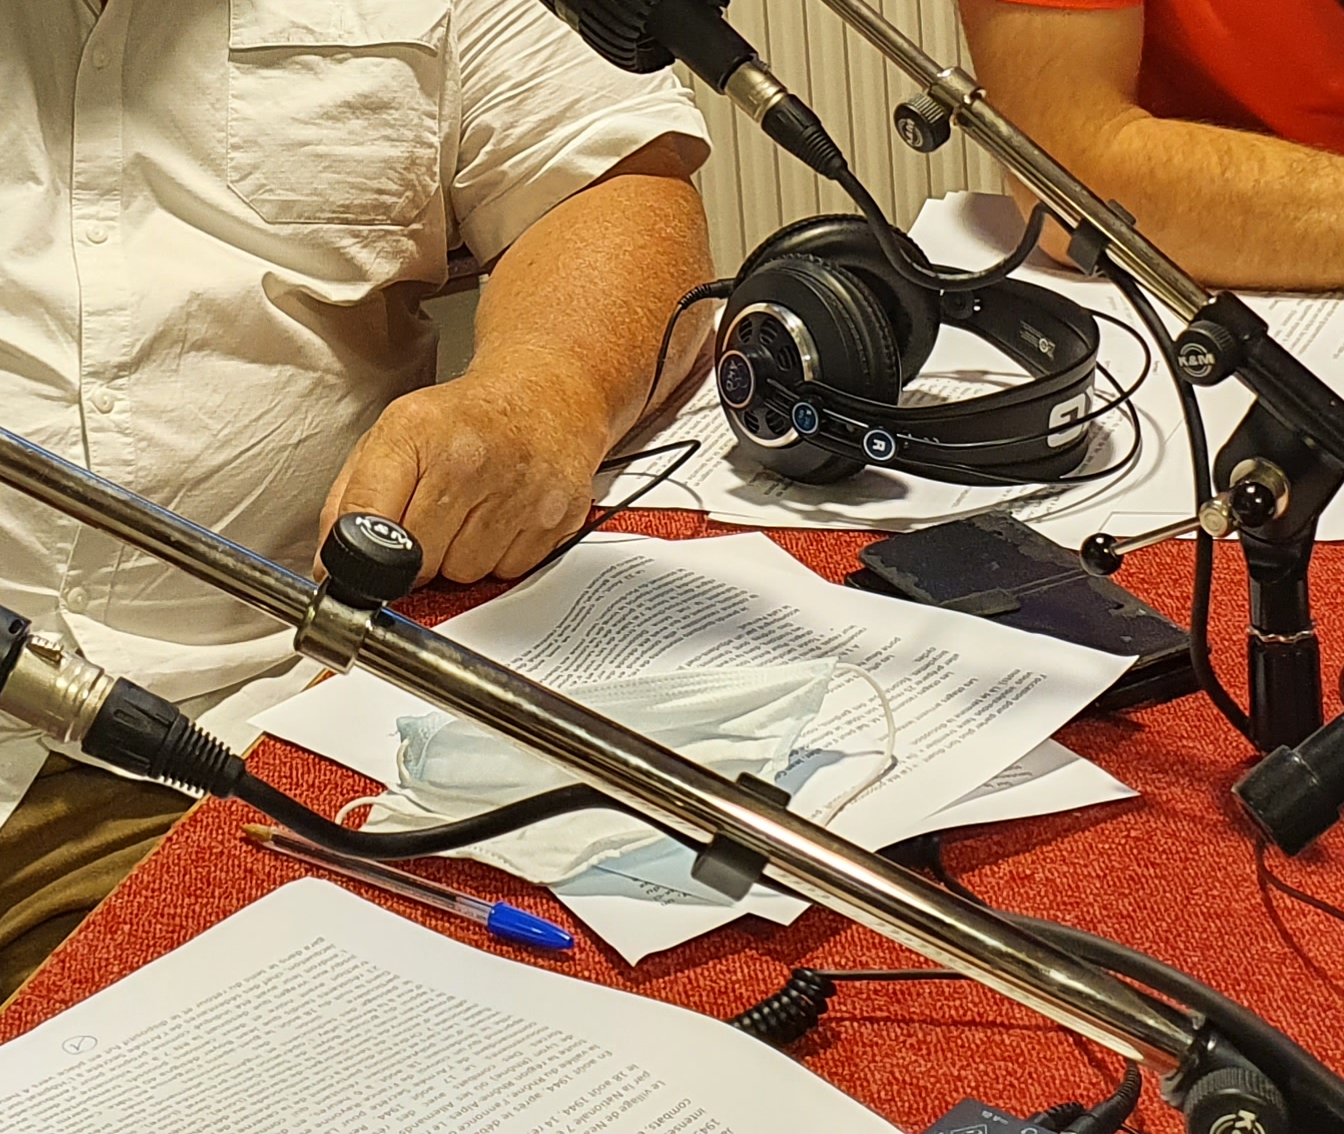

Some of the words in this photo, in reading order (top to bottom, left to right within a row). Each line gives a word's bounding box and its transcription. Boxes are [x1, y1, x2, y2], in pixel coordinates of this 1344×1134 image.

[1178, 353, 1215, 366] K&M
[872, 438, 887, 452] R
[625, 1063, 640, 1072] le
[611, 1070, 629, 1082] 18
[633, 1070, 651, 1086] par
[587, 1079, 612, 1098] août
[620, 1083, 636, 1092] la
[650, 1079, 666, 1090] Le
[512, 1092, 543, 1113] après
[618, 1089, 653, 1113] village
[573, 1090, 625, 1126] Nationale
[543, 1115, 560, 1128] 14
[604, 1110, 621, 1123] de
[643, 1098, 692, 1134] combats,
[565, 1124, 577, 1134] 7
[692, 1118, 721, 1134] 194
